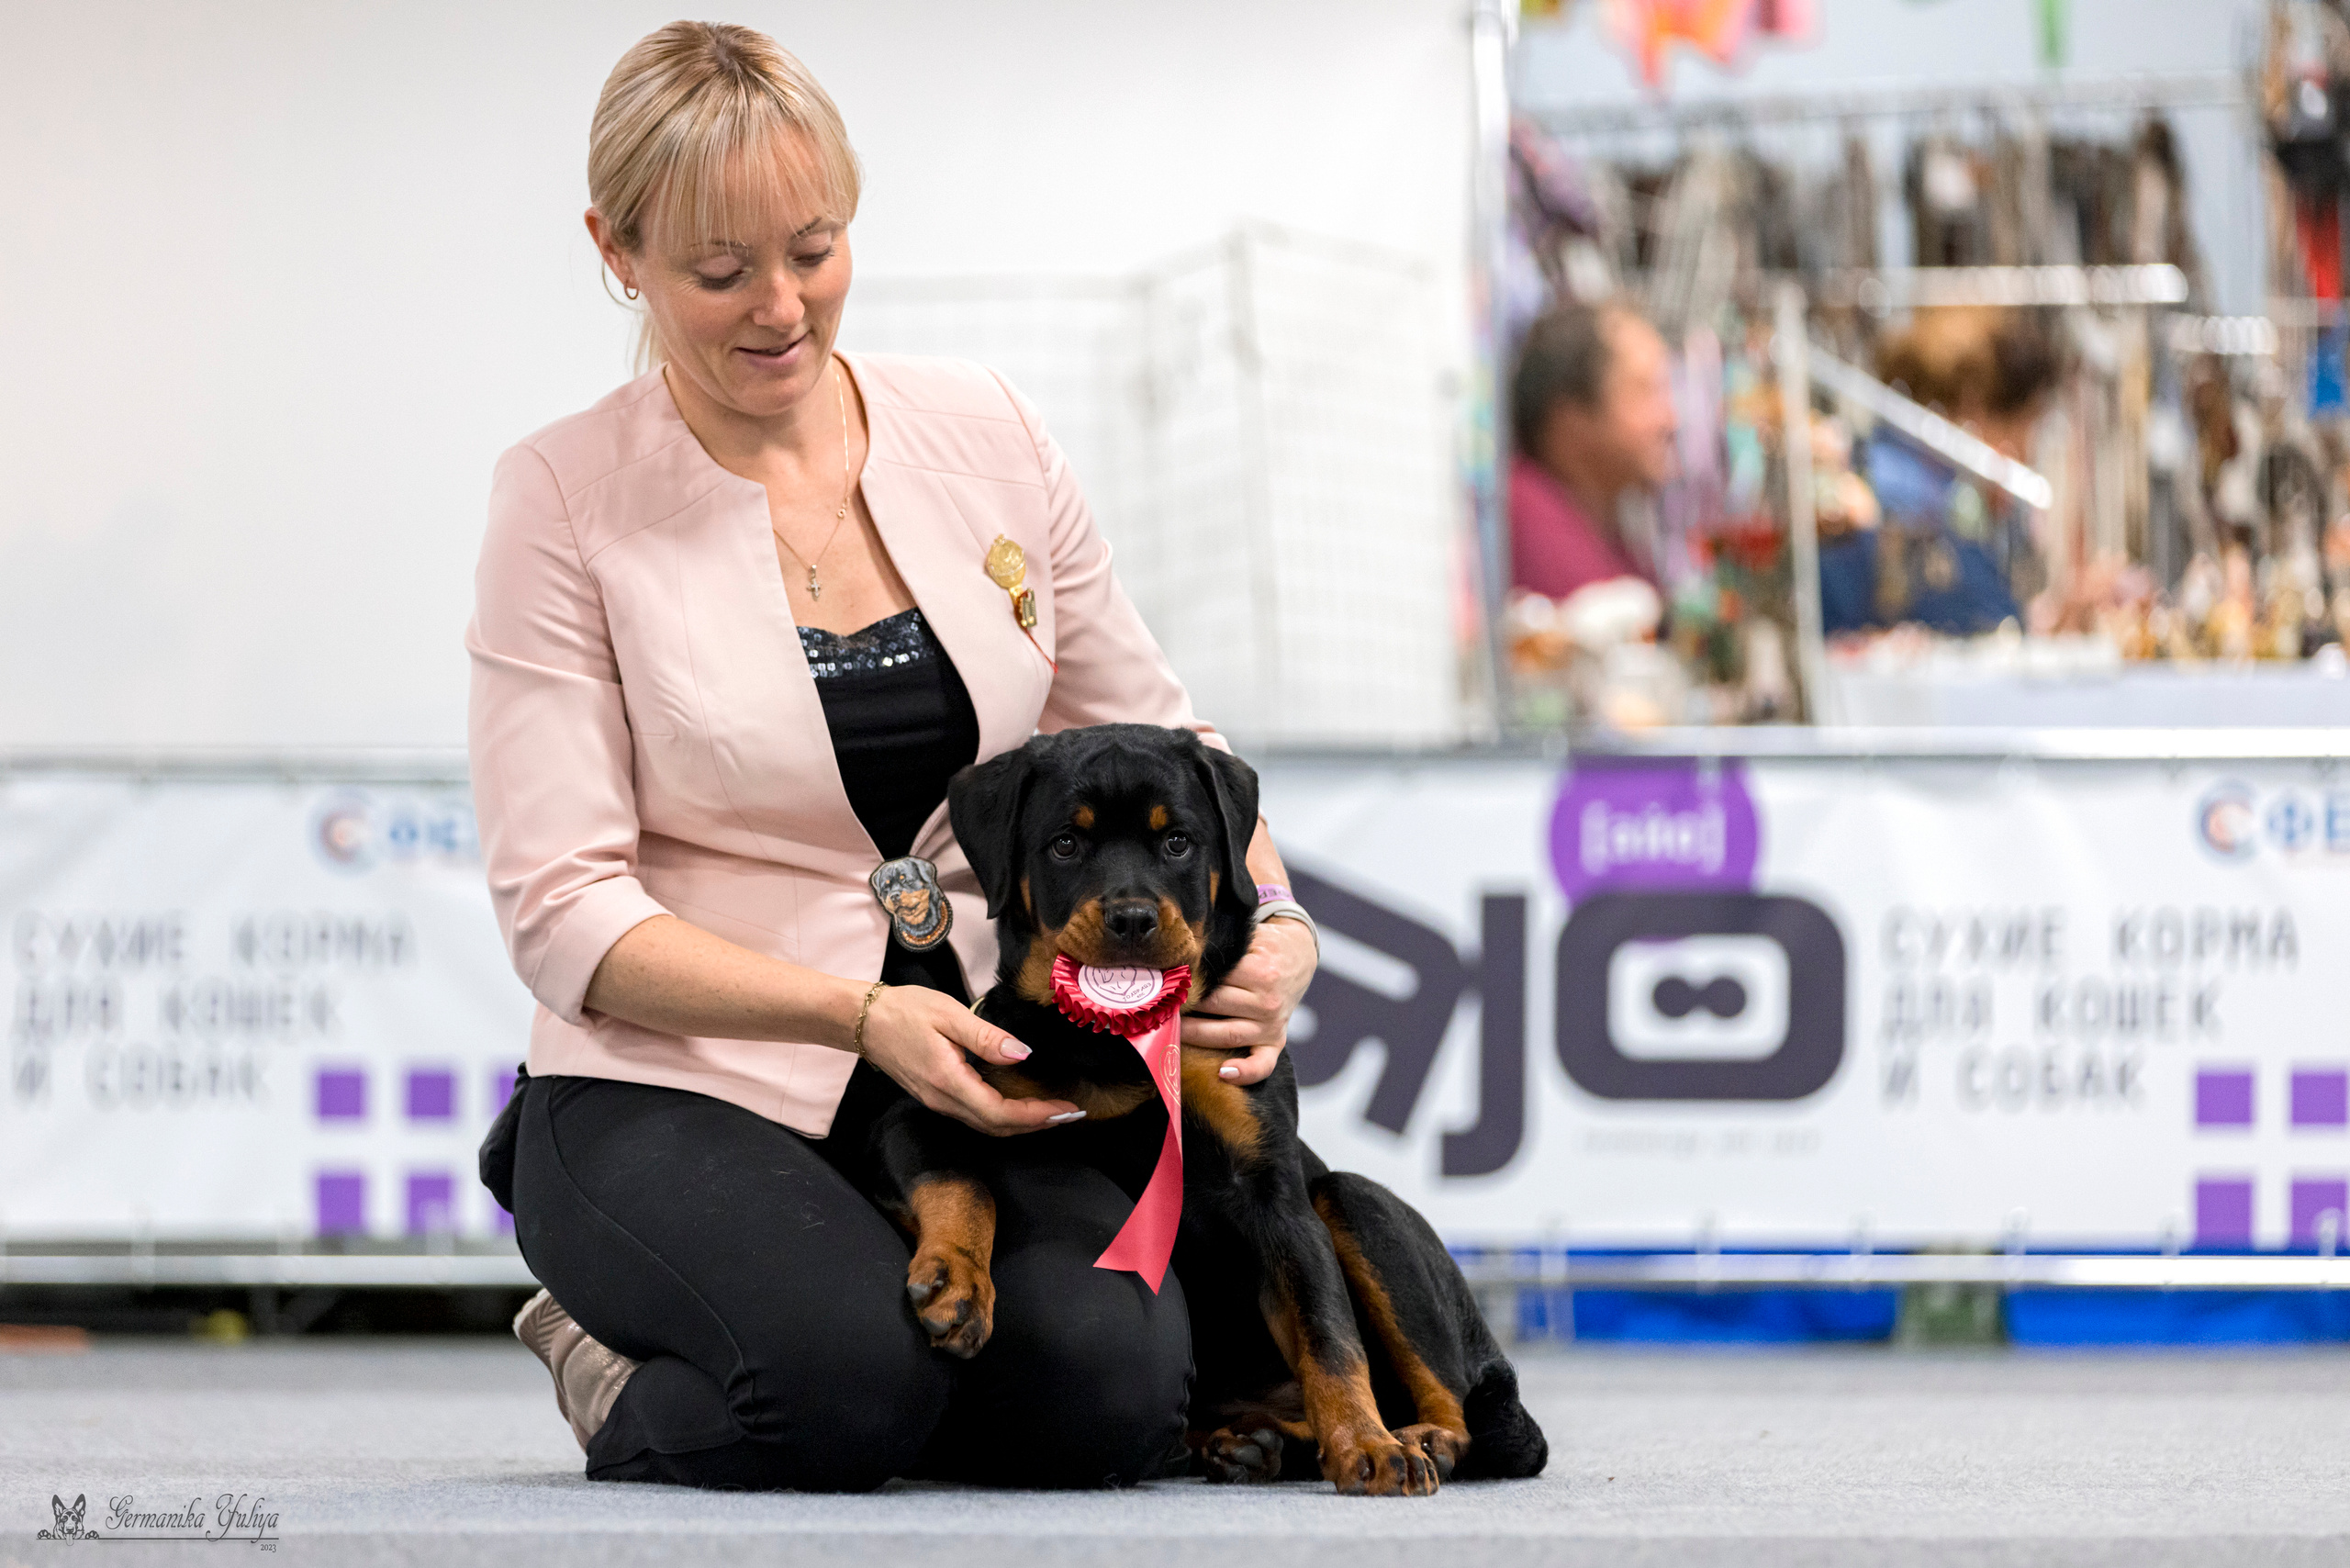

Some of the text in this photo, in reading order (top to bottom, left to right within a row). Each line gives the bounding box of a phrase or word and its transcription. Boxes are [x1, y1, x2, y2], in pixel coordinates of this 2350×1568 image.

[1882, 908, 2298, 969] СУХИЕ КОРМА
[2035, 977, 2221, 1037] КОШЕК
[1957, 1047, 2145, 1107] СОБАК
